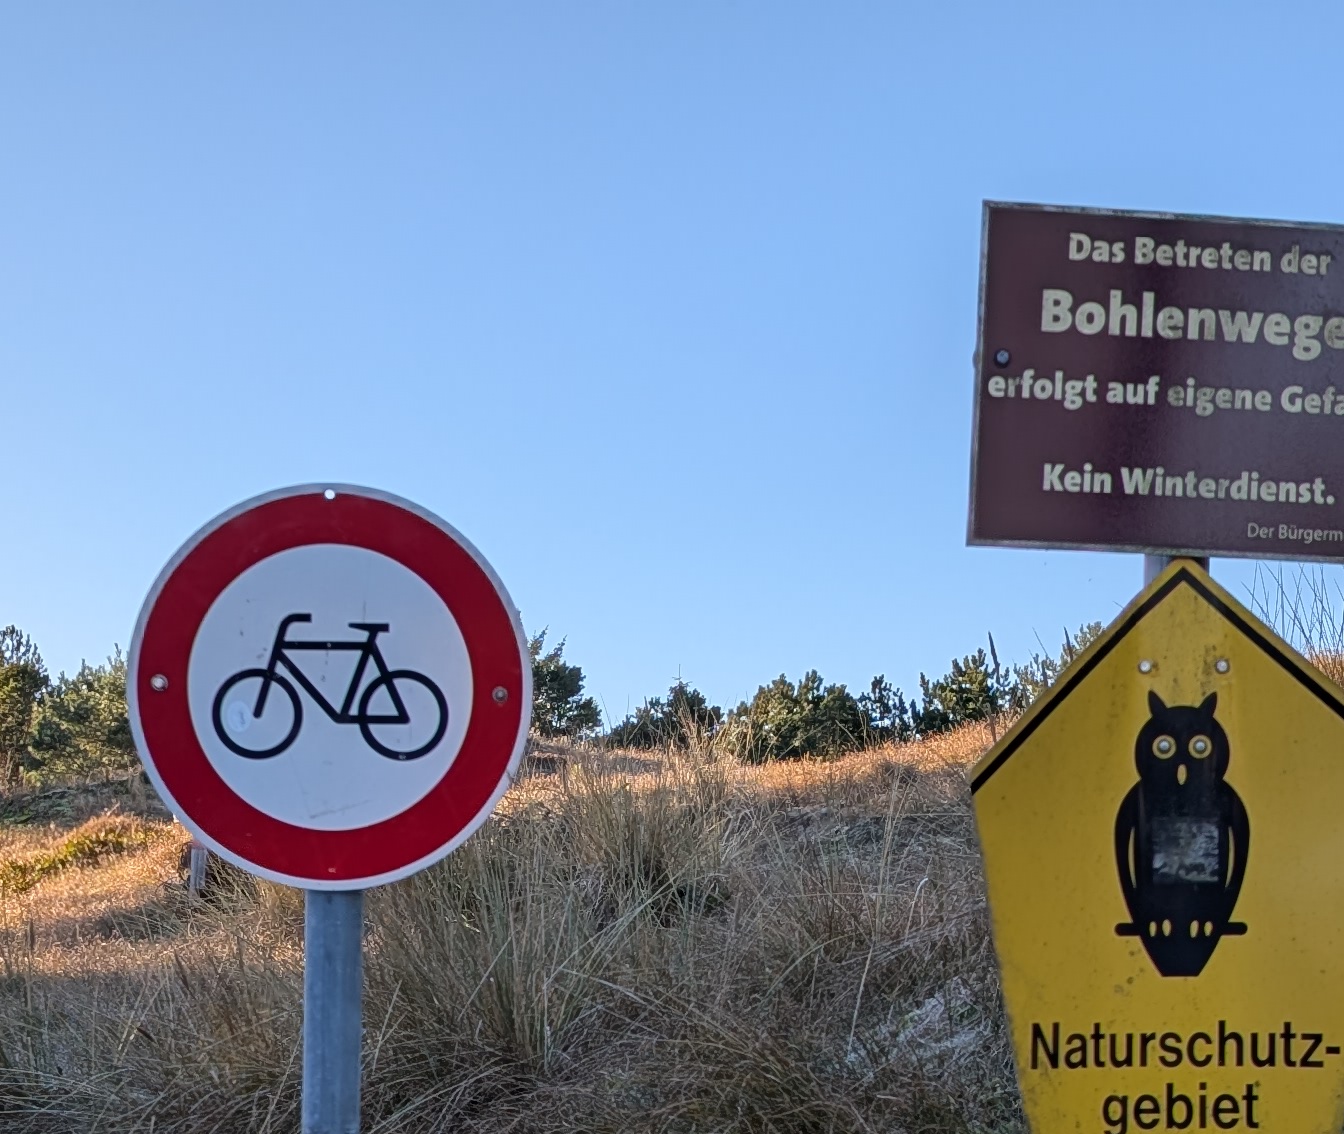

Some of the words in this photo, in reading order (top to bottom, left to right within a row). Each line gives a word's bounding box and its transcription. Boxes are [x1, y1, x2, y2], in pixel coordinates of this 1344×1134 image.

[1069, 233, 1125, 263] Das
[1135, 237, 1271, 272] Betreten
[1281, 246, 1330, 275] der
[988, 369, 1096, 410] erfolgt
[1107, 376, 1159, 405] auf
[1167, 378, 1271, 416] eigene
[1043, 463, 1111, 494] Kein
[1121, 467, 1335, 505] Winterdienst.
[1248, 523, 1273, 539] Der
[1029, 1021, 1341, 1070] Naturschutz-
